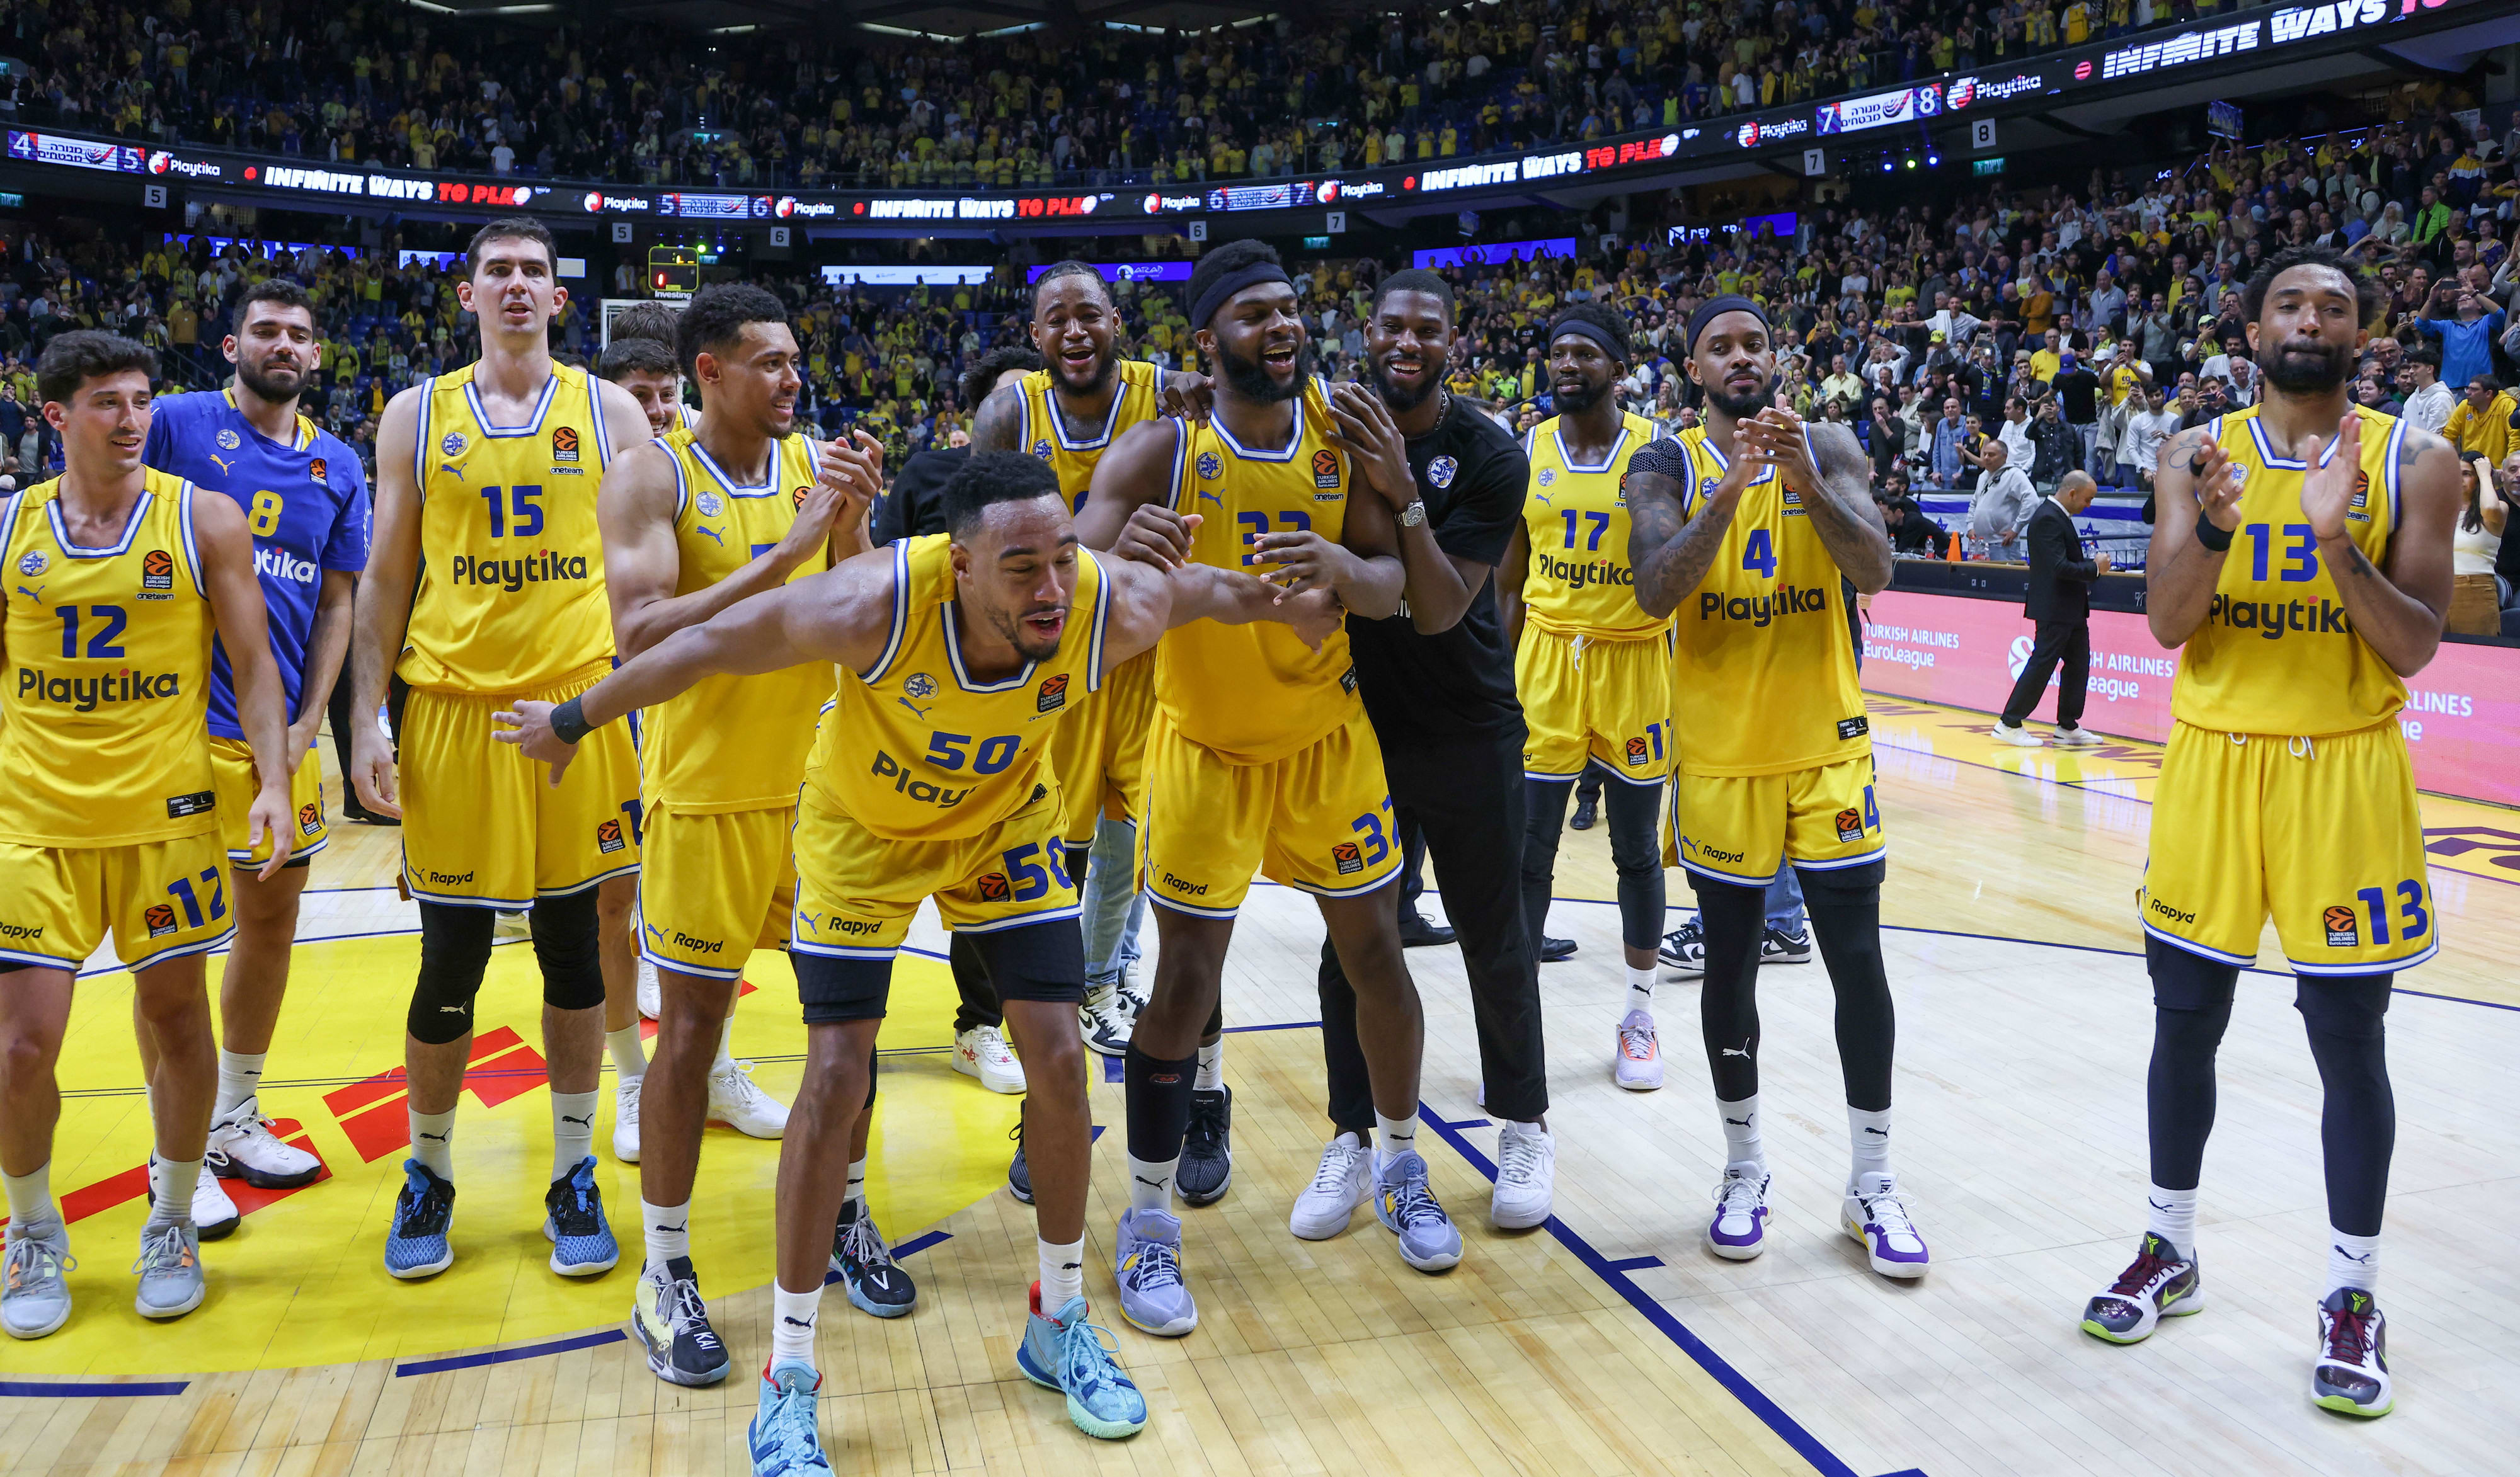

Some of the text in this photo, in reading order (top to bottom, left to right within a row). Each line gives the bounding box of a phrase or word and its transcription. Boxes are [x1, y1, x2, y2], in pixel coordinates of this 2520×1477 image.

[2102, 0, 2387, 79] INFINITE WAYS
[1976, 75, 2042, 101] Playtika
[1852, 104, 1881, 117] מנורה
[1920, 88, 1937, 115] 8
[1760, 118, 1808, 139] Playtika
[1821, 106, 1835, 130] 7
[1841, 114, 1881, 128] מבטחים
[1978, 125, 1990, 142] 8
[13, 134, 32, 157] 4
[50, 143, 83, 153] מנורה
[38, 151, 83, 162] מבטחים
[124, 148, 139, 169] 5
[1421, 133, 1680, 191] INFINITE WAYS TO PLA
[1809, 154, 1819, 170] 7
[170, 161, 220, 176] Playtika
[264, 166, 531, 205] INFINITE WAYS TO PLA
[1295, 183, 1307, 203] 7
[1341, 181, 1383, 198] Playtika
[151, 190, 161, 203] 5
[604, 197, 649, 212] Playtika
[660, 195, 675, 215] 5
[752, 197, 768, 214] 6
[869, 196, 1097, 218] INFINITE WAYS TO PLA
[1161, 195, 1200, 211] Playtika
[1209, 190, 1224, 209] 6
[793, 202, 835, 216] Playtika
[618, 226, 627, 239] 5
[1193, 225, 1201, 236] 6
[1332, 217, 1340, 228] 7
[776, 230, 784, 242] 6
[655, 290, 692, 300] Investing
[248, 490, 283, 537] 8
[480, 485, 544, 537] 15
[1561, 509, 1610, 551] 17
[1742, 529, 1777, 578] 4
[2245, 523, 2319, 582] 13
[454, 549, 587, 592] Playtika
[1700, 583, 1826, 627] Playtika
[2209, 595, 2354, 640] Playtik
[55, 605, 127, 658] 12
[1864, 622, 1959, 649] TURKISH AIRLINES
[1864, 641, 1934, 670] EuroLeague
[2107, 653, 2173, 678] AIRLINES
[18, 668, 179, 711] Playtika
[1041, 692, 1063, 701] TURKISH
[1040, 695, 1062, 706] AIRLINES
[925, 731, 1021, 774] 50
[871, 750, 976, 808] Play
[1863, 784, 1881, 833] 4
[602, 838, 621, 847] TURKISH
[1339, 858, 1360, 866] TURKISH
[1703, 845, 1744, 864] Rapyd
[1003, 836, 1074, 902] 50
[1340, 862, 1361, 870] AIRLINES
[430, 870, 474, 886] Rapyd
[1162, 872, 1208, 896] Rapyd
[168, 865, 226, 928] 12
[2151, 899, 2196, 925] Rapyd
[2357, 879, 2427, 945] 13
[828, 916, 882, 935] Rapyd
[673, 932, 724, 954] Rapyd
[694, 1332, 720, 1350] KAI
